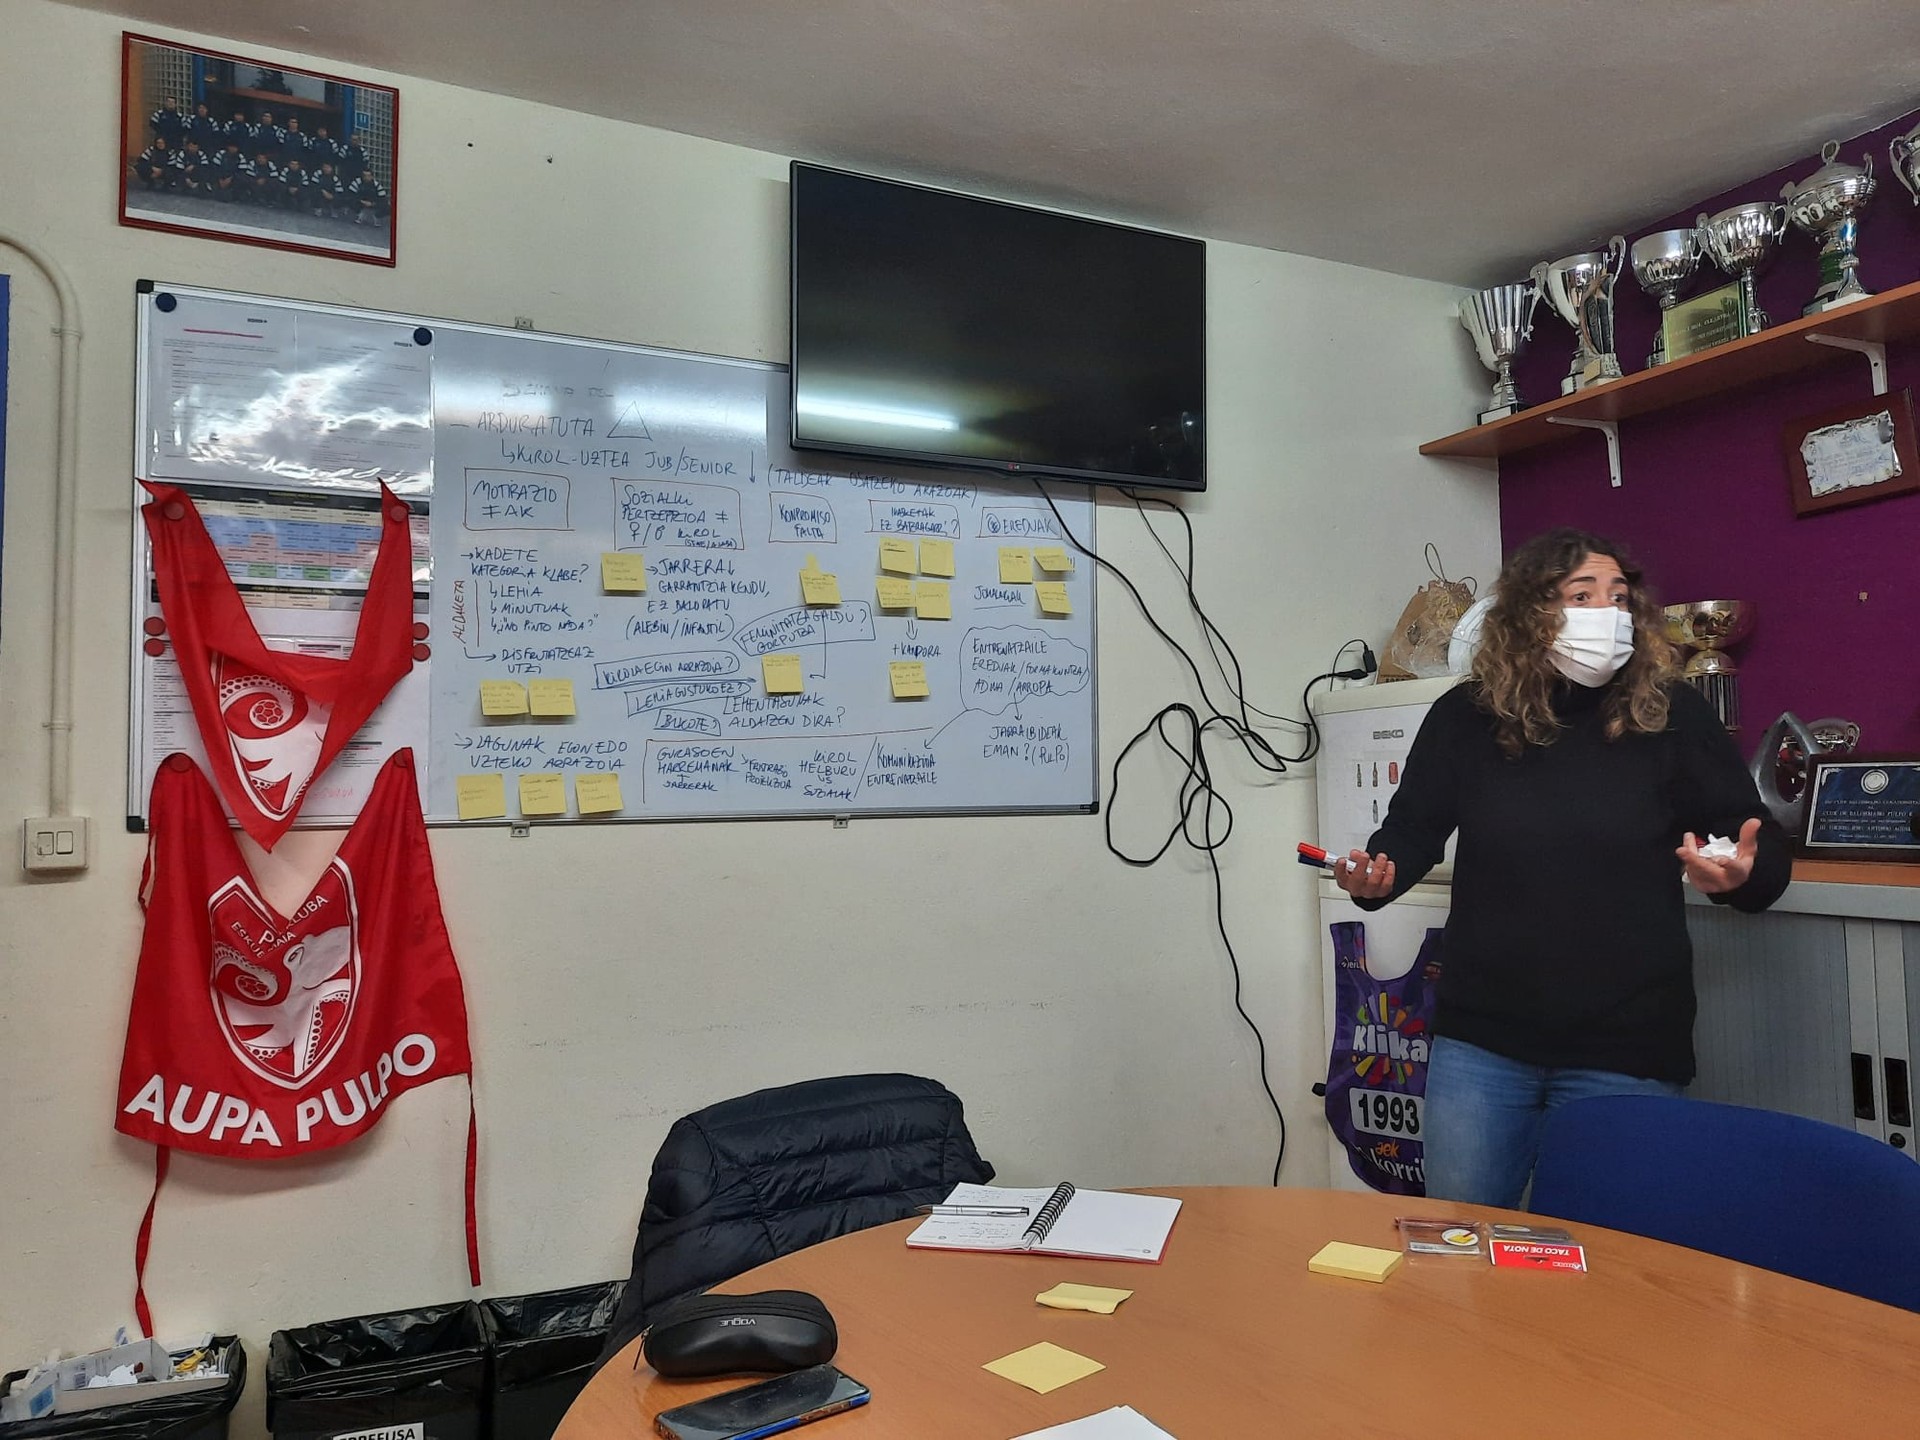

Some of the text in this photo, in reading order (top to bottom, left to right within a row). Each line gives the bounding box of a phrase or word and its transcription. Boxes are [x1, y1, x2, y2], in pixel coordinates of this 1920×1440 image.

[475, 546, 539, 563] KADETE
[501, 602, 572, 618] MINUTUAK
[508, 663, 543, 677] UTZI
[1353, 1025, 1429, 1063] Klika
[123, 1033, 438, 1148] AUPA PULPO
[1358, 1093, 1421, 1135] 1993
[1503, 1245, 1571, 1256] TACO DE NOTA
